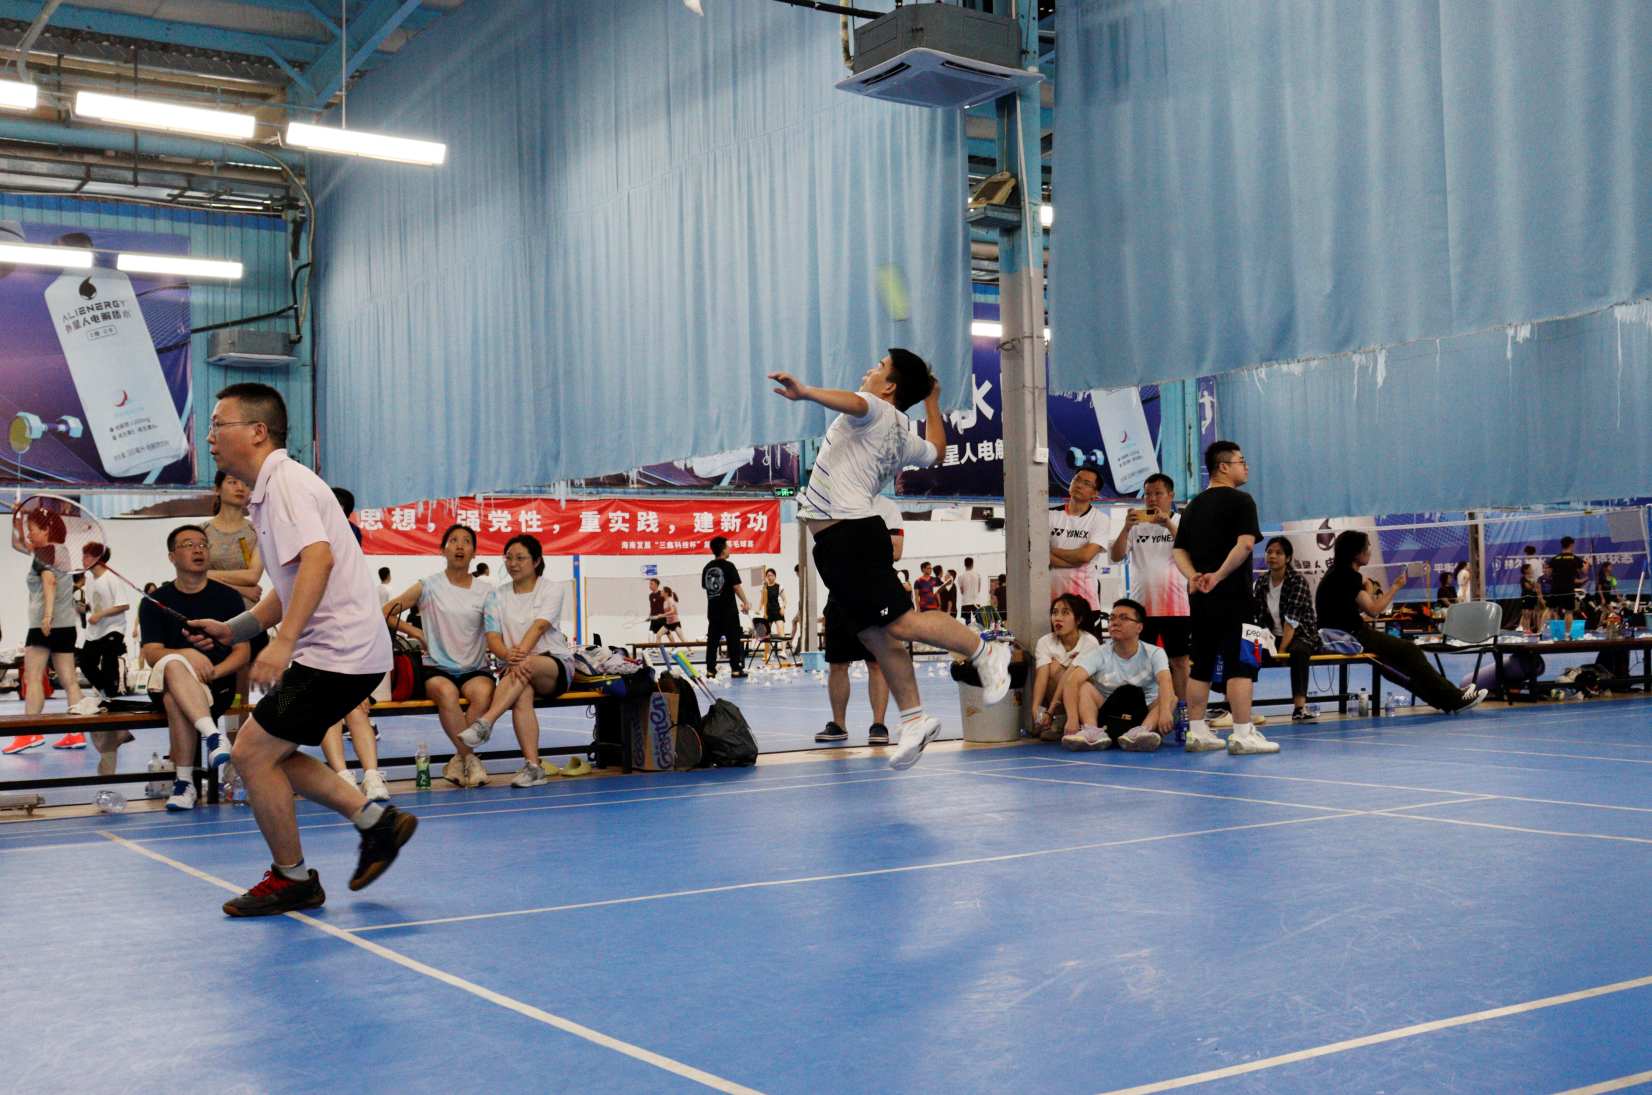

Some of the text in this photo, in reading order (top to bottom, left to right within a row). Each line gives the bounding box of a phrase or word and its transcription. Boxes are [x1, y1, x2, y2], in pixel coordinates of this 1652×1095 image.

[62, 300, 126, 323] ALIENERGY
[943, 439, 1004, 467] 星人电
[1066, 528, 1089, 539] YONEX
